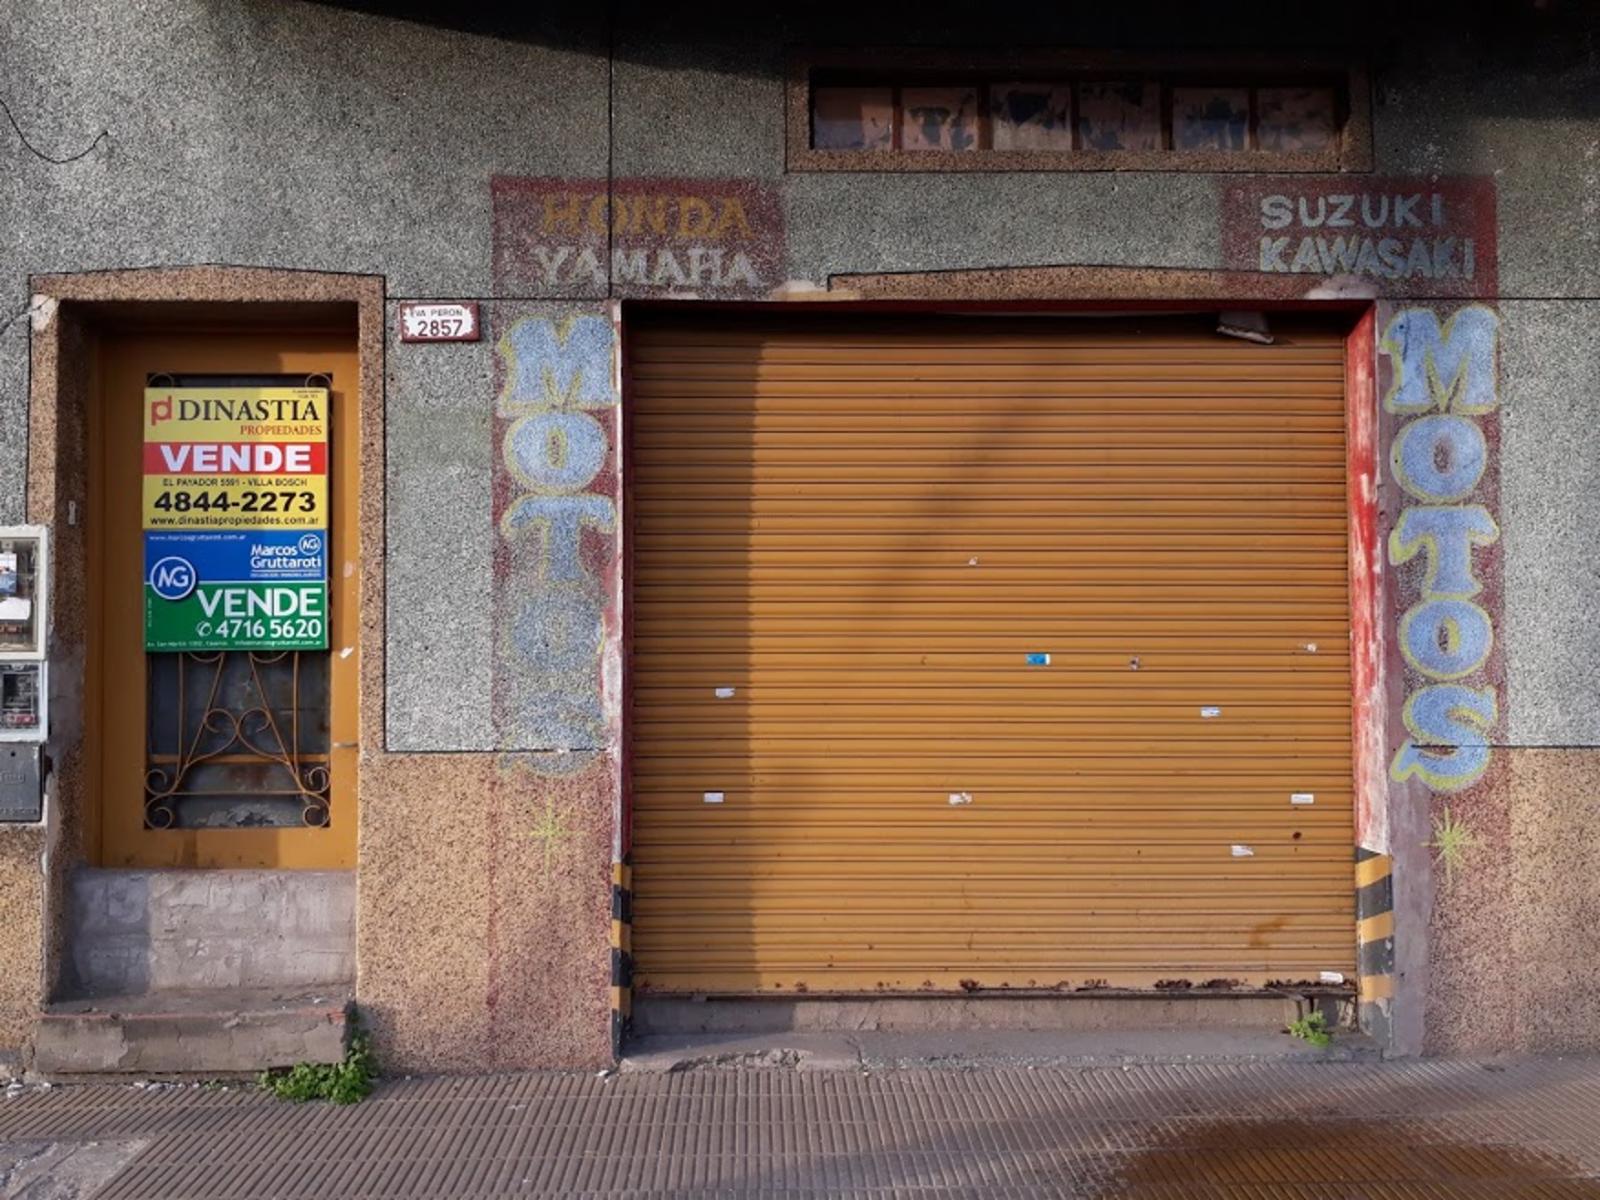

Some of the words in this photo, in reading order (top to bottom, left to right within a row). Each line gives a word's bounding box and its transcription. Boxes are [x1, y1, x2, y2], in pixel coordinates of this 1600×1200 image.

[543, 193, 757, 241] HONDA
[1260, 193, 1447, 229] SUZUKI
[531, 245, 763, 287] YAMAHA
[1259, 235, 1476, 279] KAWASAKI
[431, 308, 463, 317] PERON
[418, 319, 463, 336] 2857
[178, 399, 320, 421] DINASTIA
[240, 425, 322, 435] PROPIEDADES
[160, 444, 311, 472] VENDE
[163, 478, 173, 487] EL
[177, 478, 218, 487] PAYADOR
[248, 478, 273, 487] VILLA
[275, 478, 307, 487] BOSCH
[154, 492, 316, 512] 4844-2273
[150, 515, 319, 526] www.dinastiapropiedades.com.ar
[250, 544, 297, 556] Marcos
[1380, 304, 1501, 792] MOTOS
[250, 556, 321, 569] Gruttaroti
[196, 588, 322, 617] VENDE
[215, 620, 265, 638] 4716
[270, 619, 322, 637] 5620
